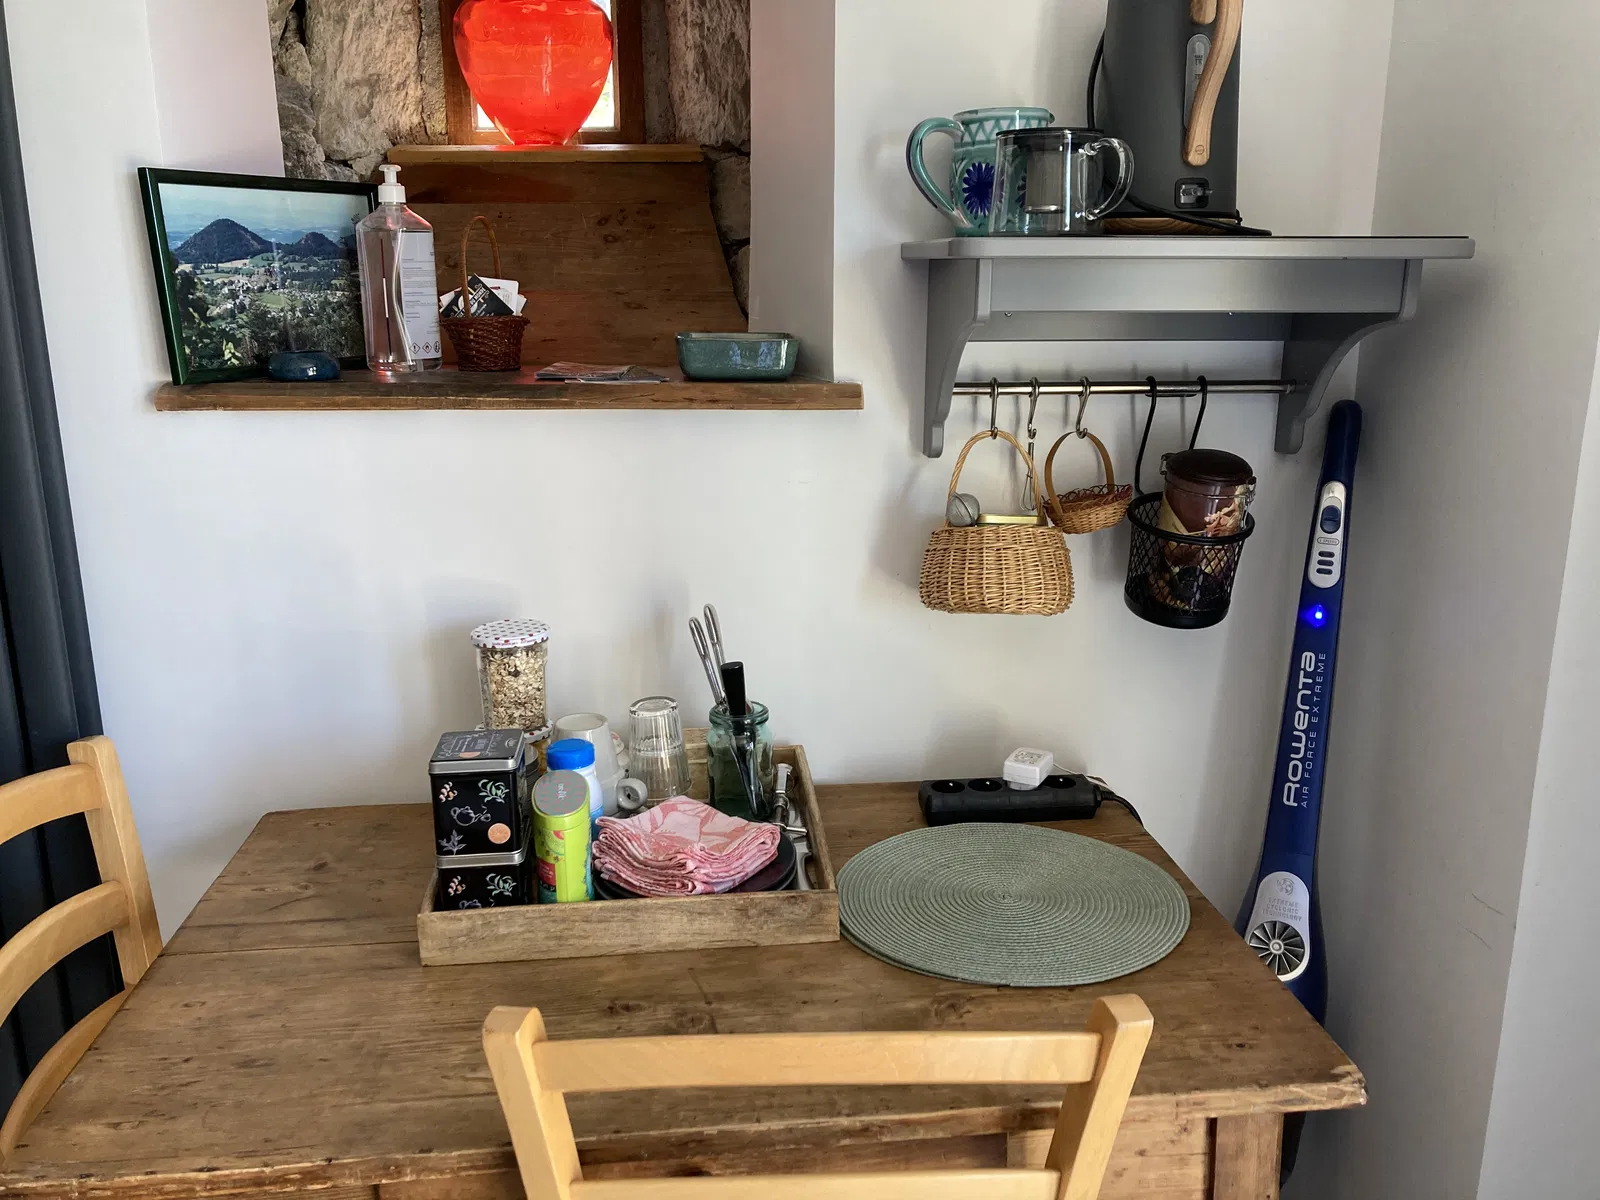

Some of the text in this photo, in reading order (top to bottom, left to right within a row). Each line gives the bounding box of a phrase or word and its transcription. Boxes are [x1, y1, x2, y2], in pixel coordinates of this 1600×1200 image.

[1300, 652, 1326, 807] AIR FORCE EXTREME
